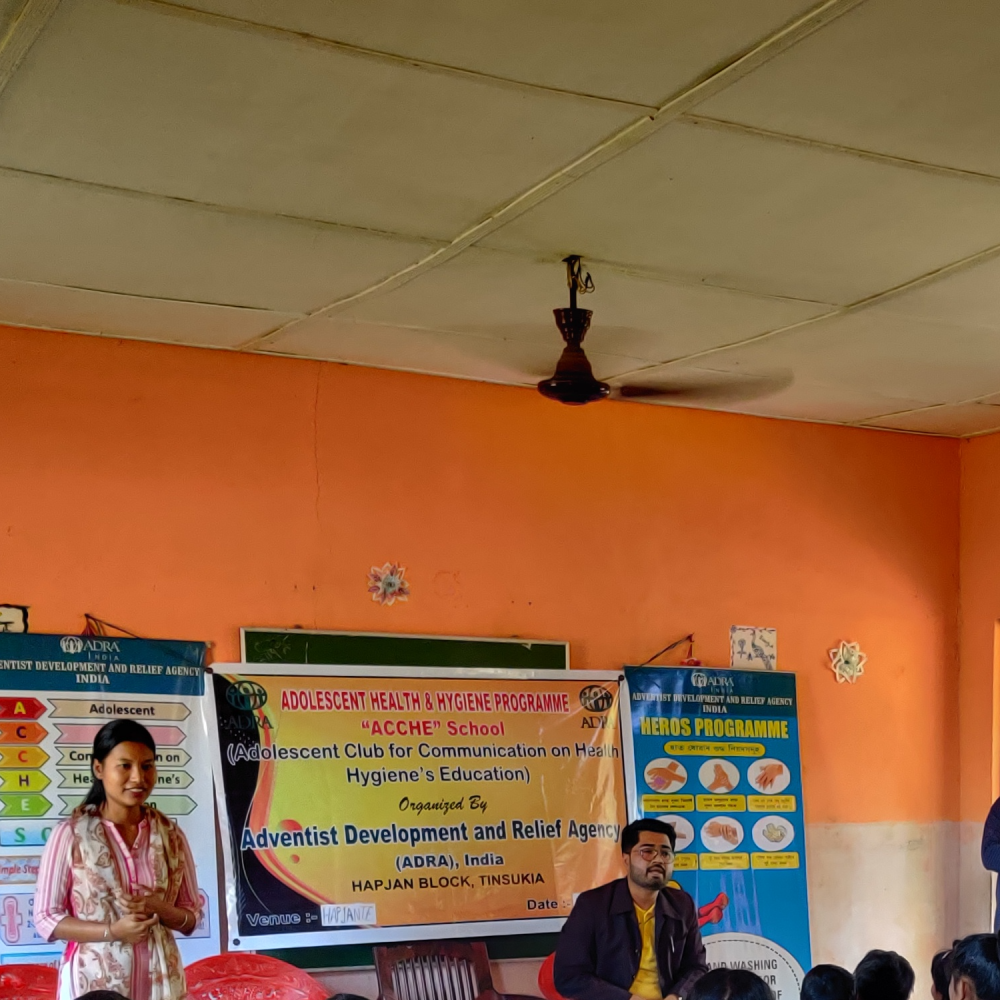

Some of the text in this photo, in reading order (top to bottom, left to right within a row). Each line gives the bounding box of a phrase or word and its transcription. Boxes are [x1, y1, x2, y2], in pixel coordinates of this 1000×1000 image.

[83, 640, 121, 653] ADRA
[88, 652, 120, 662] INDIA
[35, 661, 107, 674] DEVELOPMENT
[108, 664, 129, 674] AND
[129, 664, 164, 676] RELIEF
[165, 666, 201, 677] AGENCY
[76, 674, 111, 685] INDIA
[707, 676, 735, 688] ADRA
[281, 690, 570, 713] ADOLESCENT HEALTH & HYGIENE PROGRAMME
[632, 692, 794, 707] ADVENTIST DEVELOPMENT AND RELIEF AGENCY
[13, 701, 27, 716] A
[89, 703, 157, 716] Adolescent
[702, 704, 729, 714] INDIA
[15, 726, 27, 739] C
[447, 721, 506, 737] School
[639, 716, 790, 740] HEROS PROGRAMME
[17, 750, 28, 763] C
[165, 753, 180, 763] on
[227, 743, 619, 766] (Adolescent Club for Communication on Health
[18, 774, 30, 788] H
[439, 766, 531, 785] Education)
[21, 799, 30, 812] E
[399, 795, 489, 816] Organized By
[240, 819, 621, 850] Adventist Development and Relief Agency
[395, 853, 505, 873] (ADRA), India
[352, 873, 546, 893] HAPJAN BLOCK, TINSUKIA
[527, 899, 559, 911] Date
[246, 911, 302, 927] Venue
[708, 959, 778, 972] AND WASHING
[763, 974, 777, 986] OR
